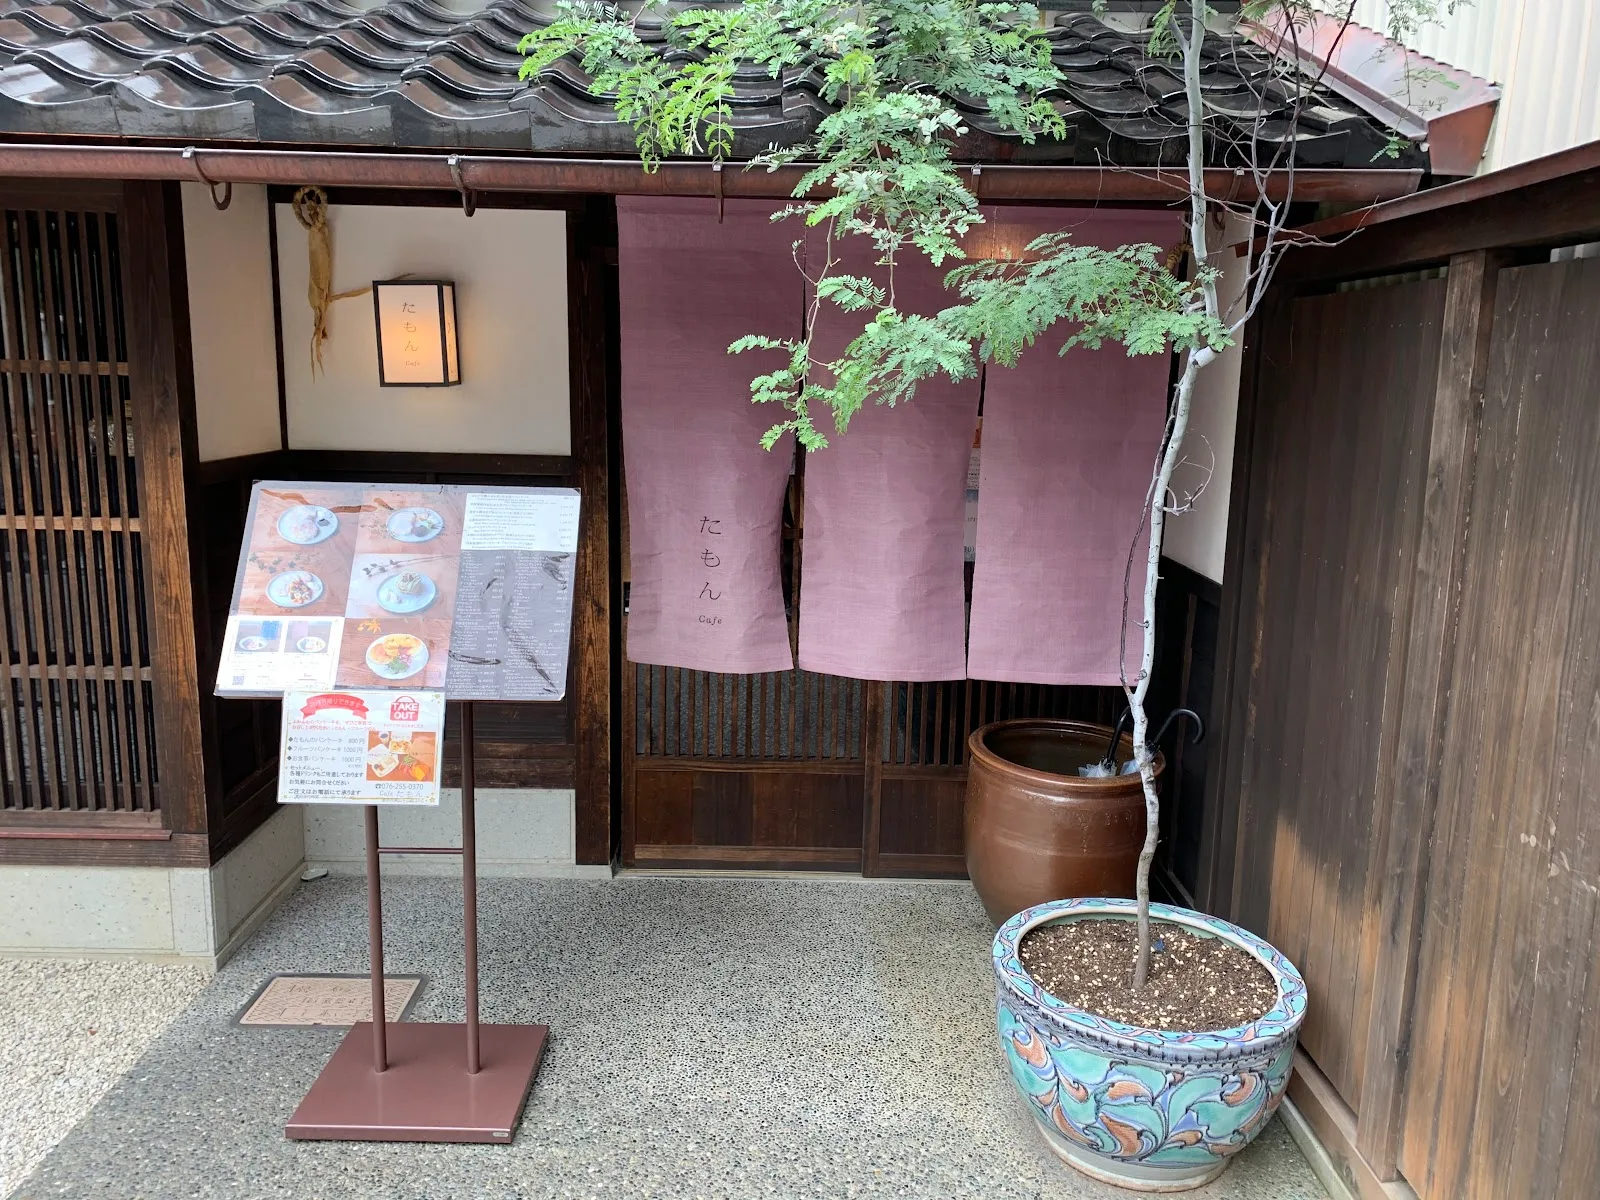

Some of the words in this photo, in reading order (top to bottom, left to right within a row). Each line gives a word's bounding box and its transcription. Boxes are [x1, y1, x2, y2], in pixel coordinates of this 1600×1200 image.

[402, 302, 418, 352] たもん
[699, 516, 721, 600] たもん
[699, 615, 722, 625] Cafe
[392, 703, 418, 711] TAKE
[394, 711, 415, 720] OUT
